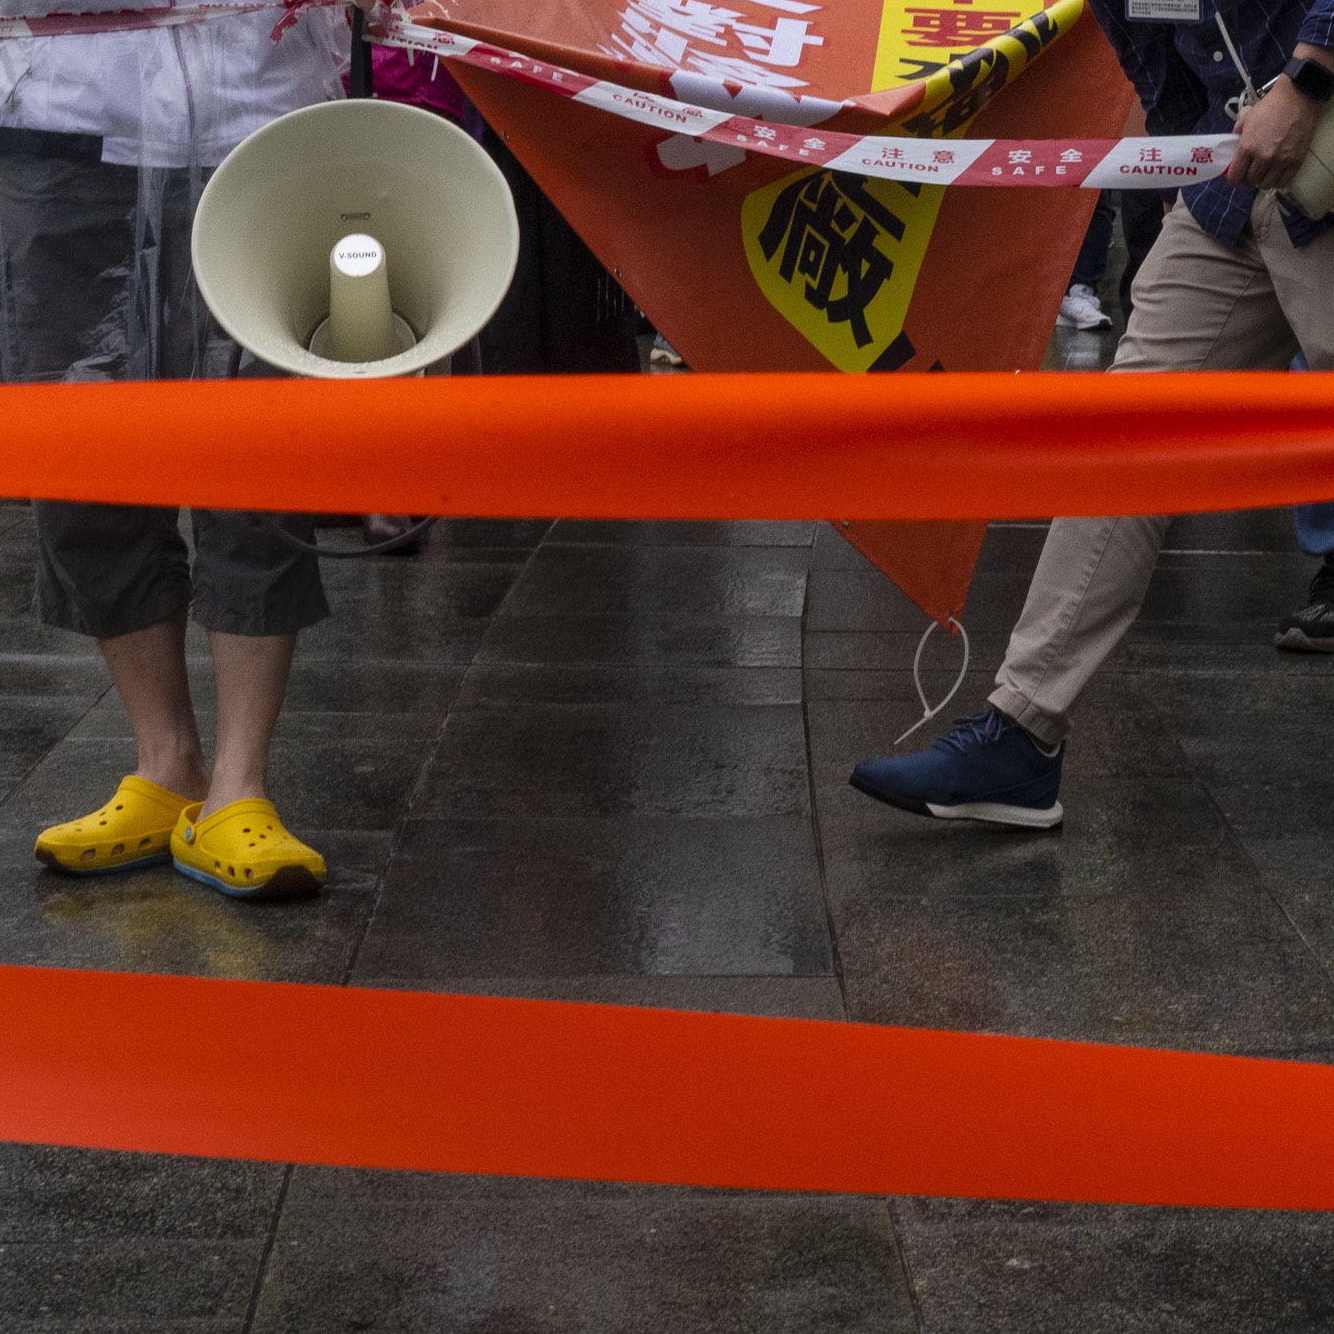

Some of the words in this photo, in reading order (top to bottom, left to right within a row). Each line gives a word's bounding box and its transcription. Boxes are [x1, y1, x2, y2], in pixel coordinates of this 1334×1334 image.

[490, 56, 564, 83] SAFE
[612, 93, 687, 124] CAUTION
[736, 134, 810, 157] SAFE
[882, 147, 955, 164] 注意
[1008, 148, 1083, 165] 安全
[1139, 146, 1214, 165] 注意
[862, 157, 940, 173] CAUTION
[991, 165, 1067, 176] SAFE
[1119, 164, 1198, 177] CAUTION
[339, 251, 377, 260] V-SOUND
